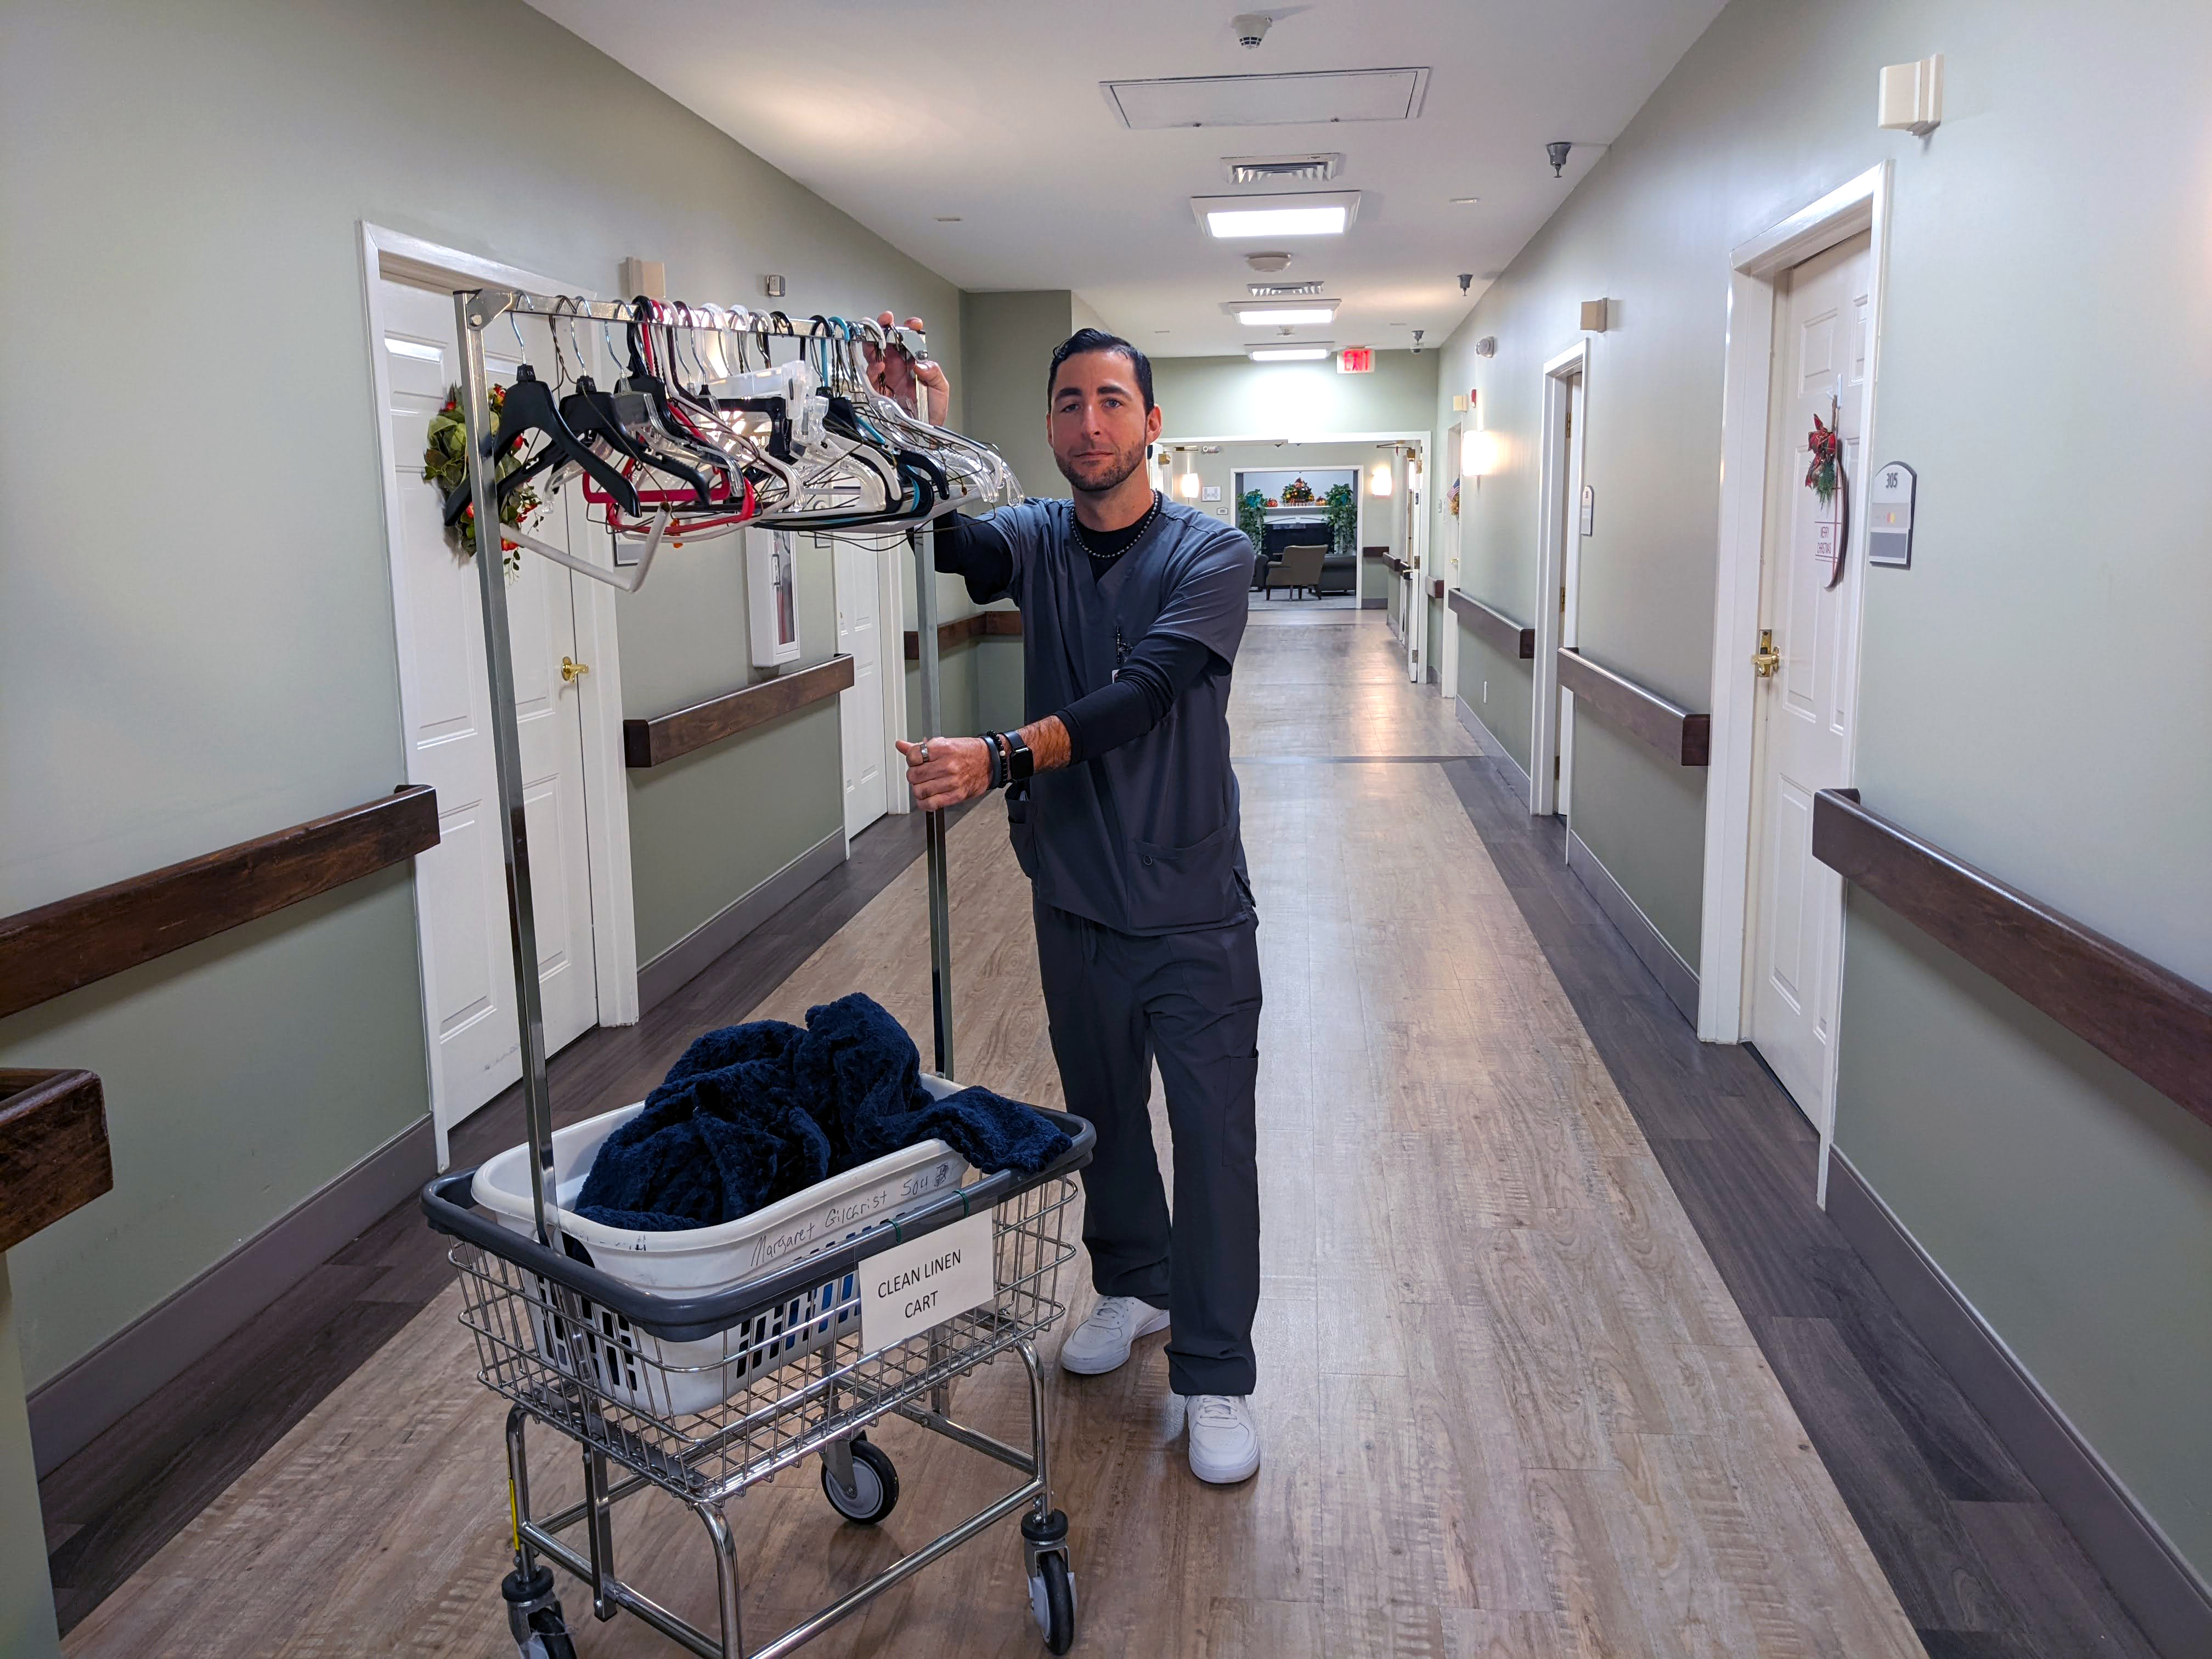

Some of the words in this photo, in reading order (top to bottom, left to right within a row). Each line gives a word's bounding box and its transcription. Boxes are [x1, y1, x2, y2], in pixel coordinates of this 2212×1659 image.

[1344, 351, 1369, 371] EXIT
[1886, 472, 1898, 489] 305
[751, 1222, 815, 1267] Margaret
[878, 1267, 920, 1298] CLEAN
[924, 1249, 961, 1278] LINEN
[905, 1290, 938, 1318] CART
